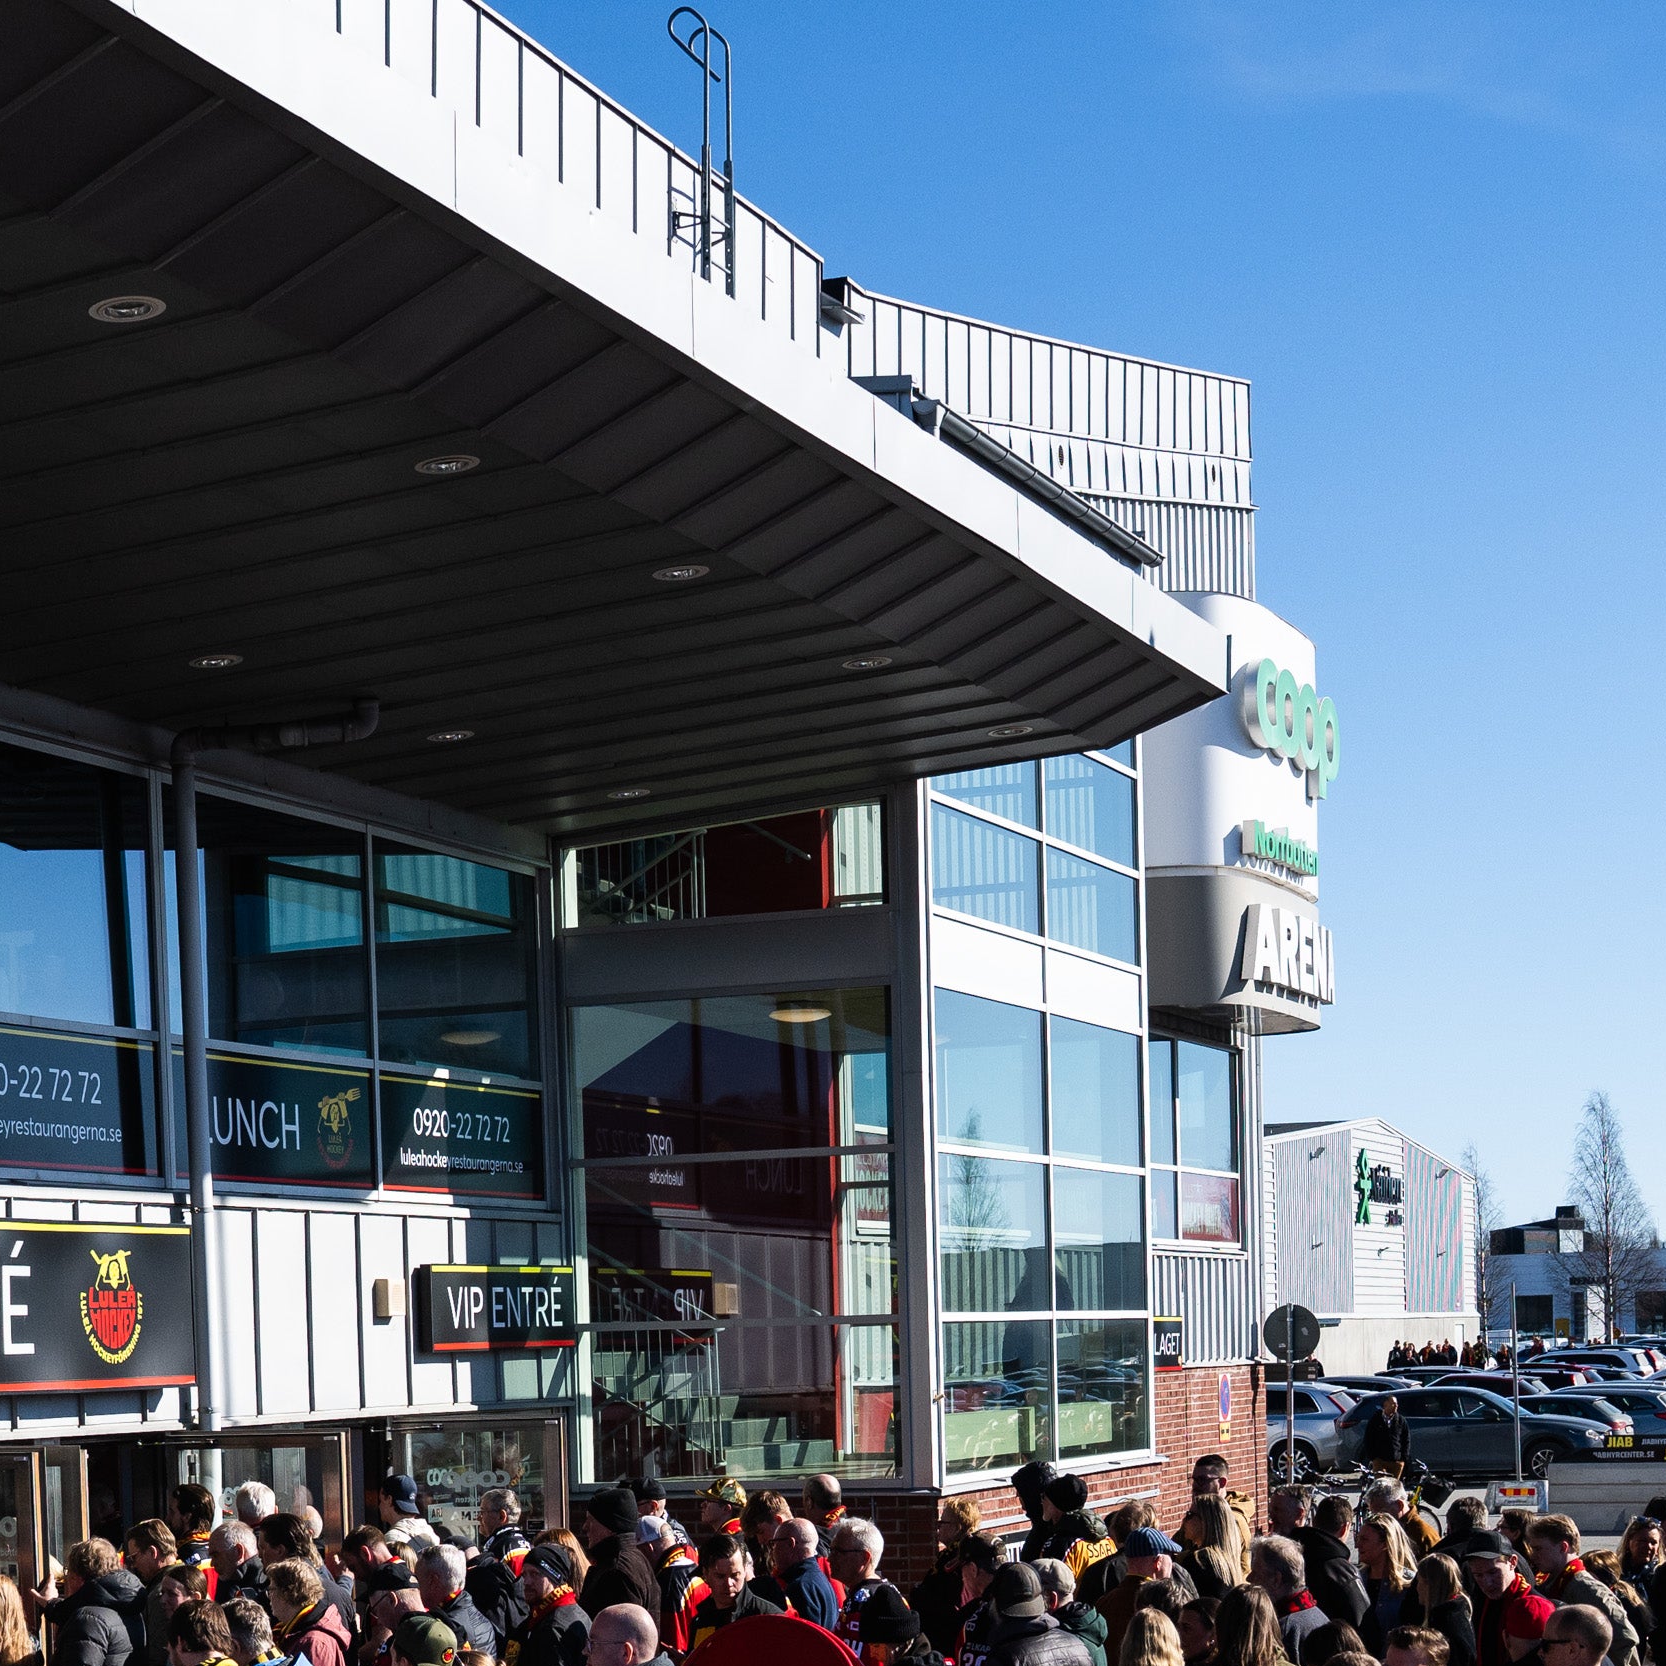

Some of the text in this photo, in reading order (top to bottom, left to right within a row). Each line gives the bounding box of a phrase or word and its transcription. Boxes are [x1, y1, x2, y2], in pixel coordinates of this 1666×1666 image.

[1247, 657, 1341, 800] coop
[49, 1066, 74, 1103] 72
[78, 1069, 102, 1106] 72
[209, 1098, 301, 1151] UNCH
[413, 1107, 510, 1143] 0920-22 72 72
[400, 1147, 524, 1175] luleahockeyrestaurangerna.se
[88, 1284, 136, 1308] LULEÅ
[447, 1286, 484, 1330] VIP
[491, 1276, 563, 1329] ENTRÉ
[89, 1308, 136, 1349] HOCKEY
[1607, 1436, 1633, 1448] JIAB
[1086, 1543, 1113, 1559] SSAB
